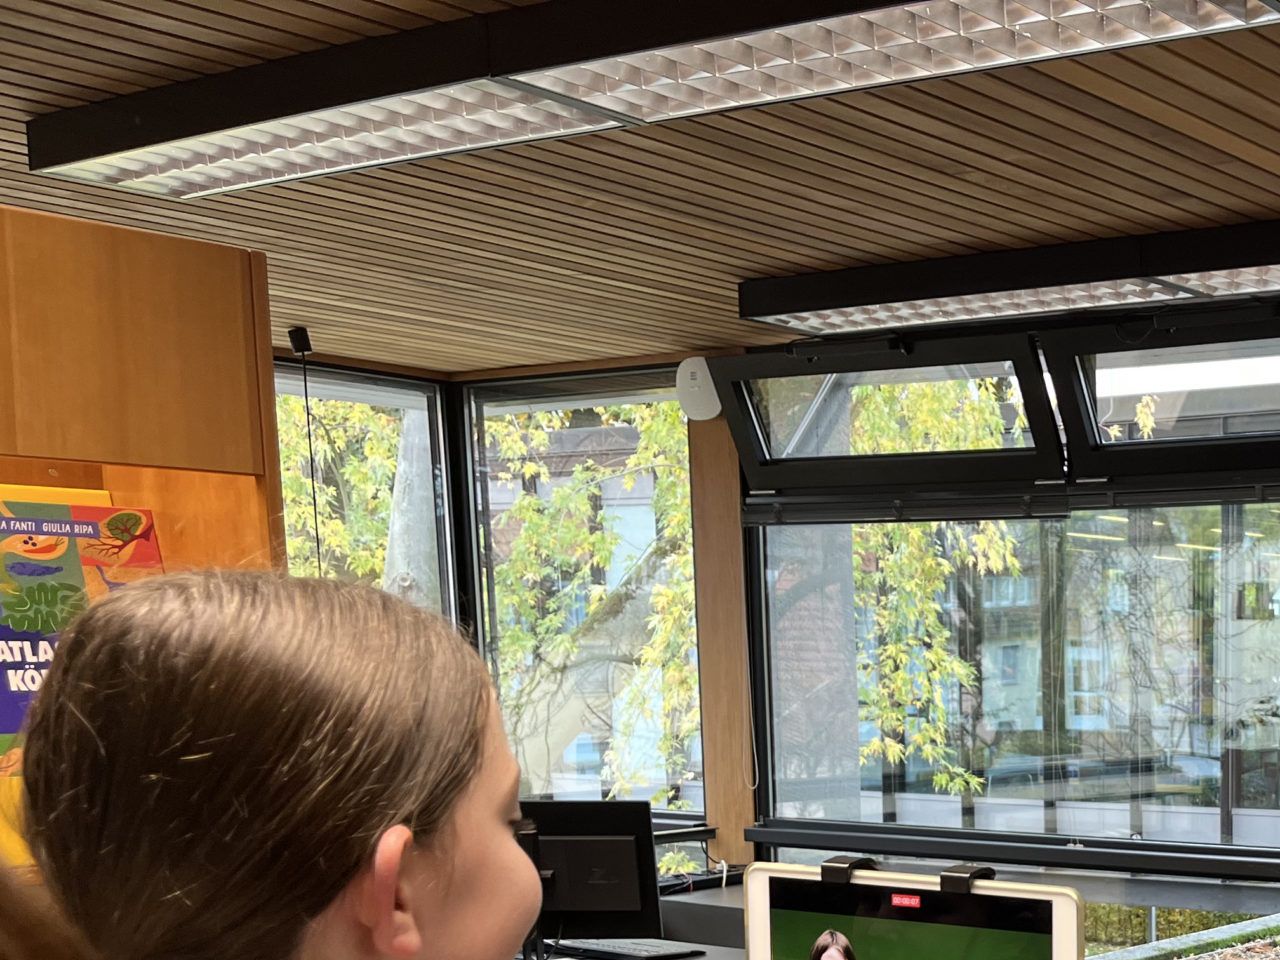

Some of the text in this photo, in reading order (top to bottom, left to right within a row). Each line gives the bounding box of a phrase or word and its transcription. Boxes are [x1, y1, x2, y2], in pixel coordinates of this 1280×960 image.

[10, 520, 36, 532] FANTI
[42, 522, 71, 534] GIULIA
[74, 524, 94, 535] RIPA
[0, 640, 59, 663] ATLA
[7, 664, 49, 692] KÖ
